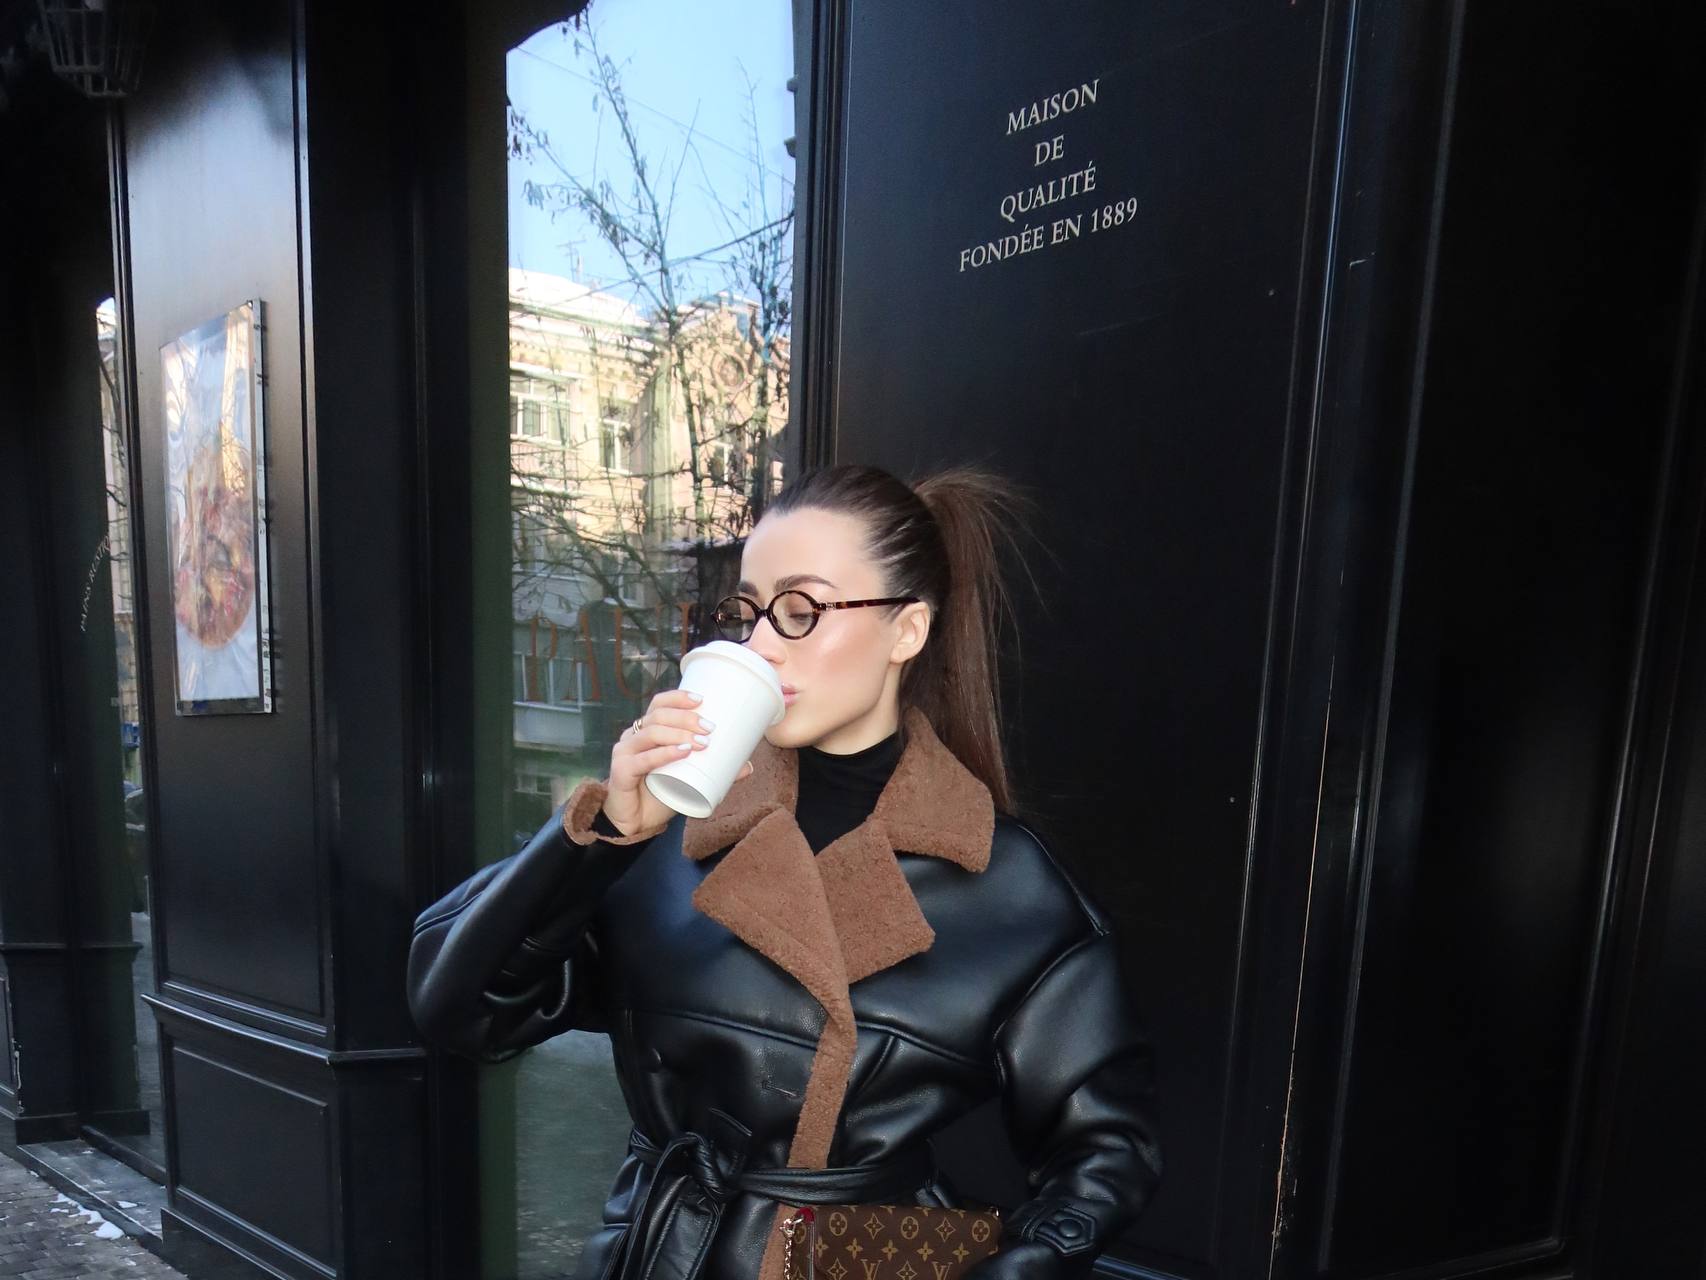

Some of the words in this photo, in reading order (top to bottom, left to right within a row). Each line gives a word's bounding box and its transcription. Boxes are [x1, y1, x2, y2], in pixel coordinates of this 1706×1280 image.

[1005, 78, 1100, 135] MAISON
[1034, 134, 1065, 167] DE
[1000, 160, 1097, 223] QUALITÉ
[959, 223, 1044, 273] FONDÉE
[1050, 214, 1082, 245] EN
[1091, 197, 1138, 233] 1889
